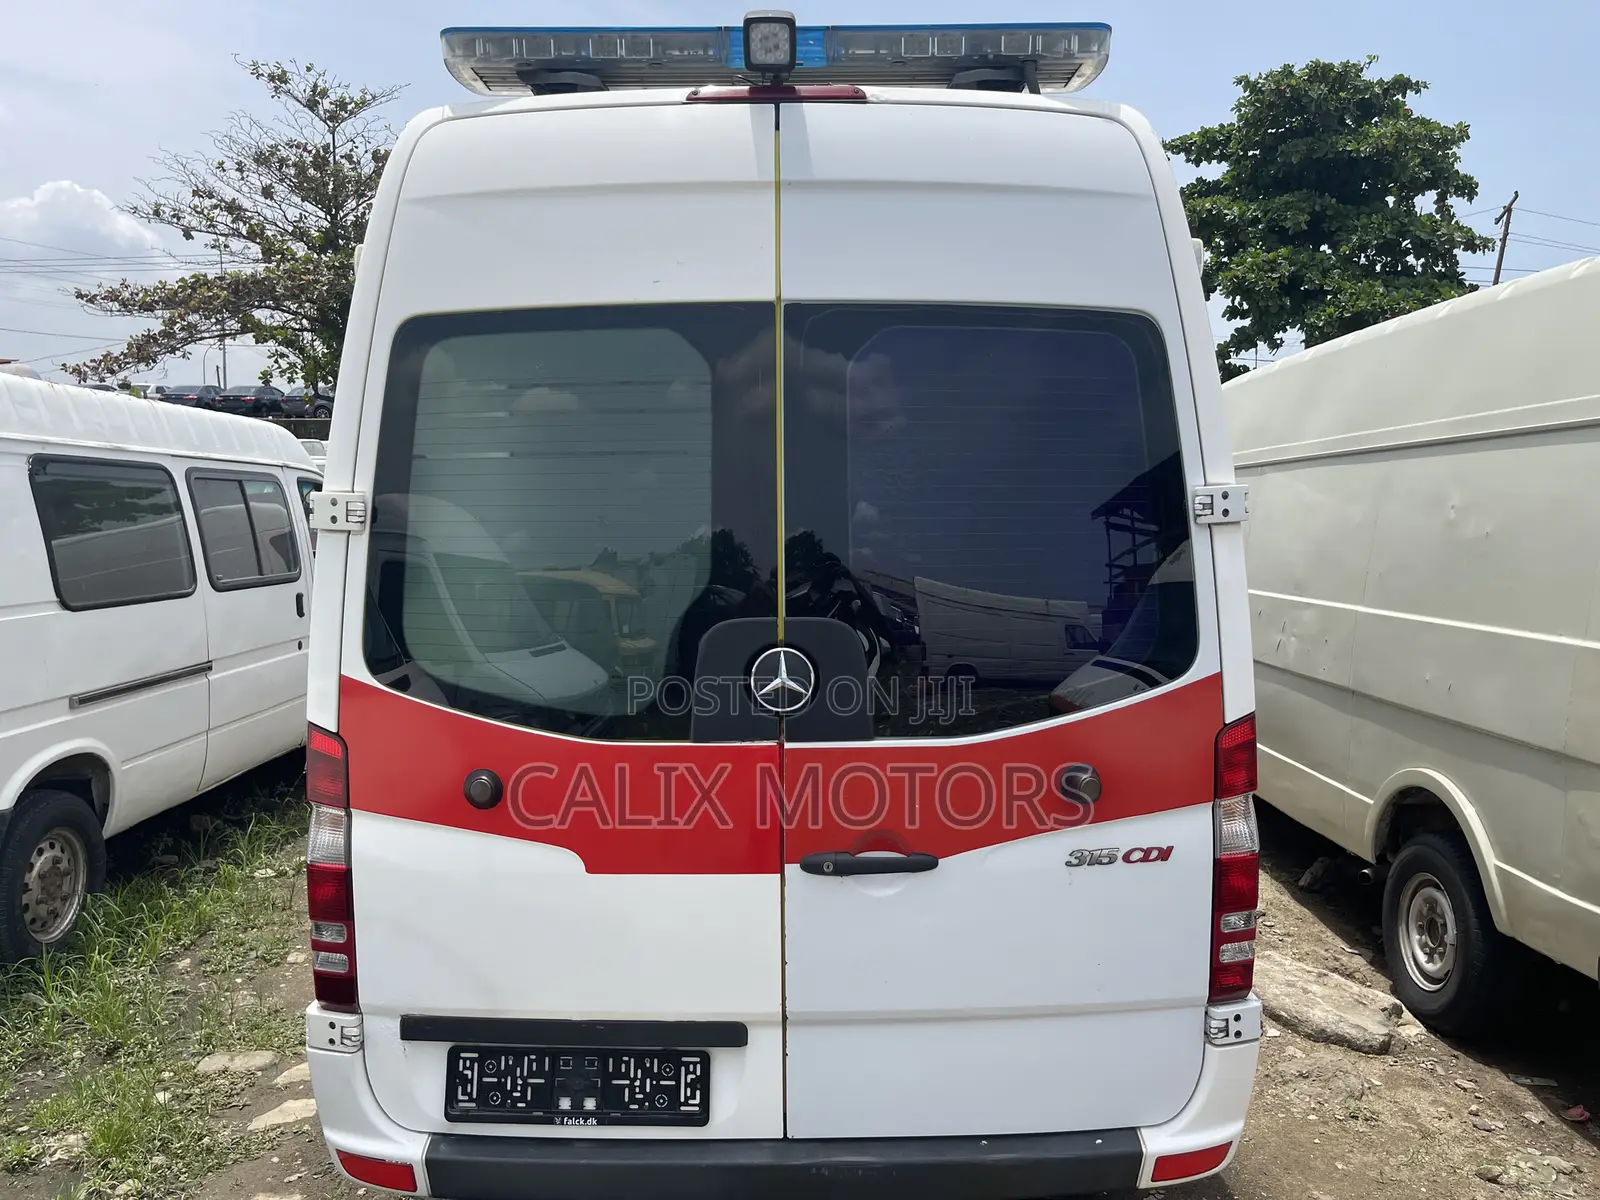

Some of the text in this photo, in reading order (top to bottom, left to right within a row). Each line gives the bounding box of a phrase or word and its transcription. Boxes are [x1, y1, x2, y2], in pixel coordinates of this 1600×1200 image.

[1064, 845, 1175, 867] 315 CDI
[563, 1116, 598, 1126] falck.dk
